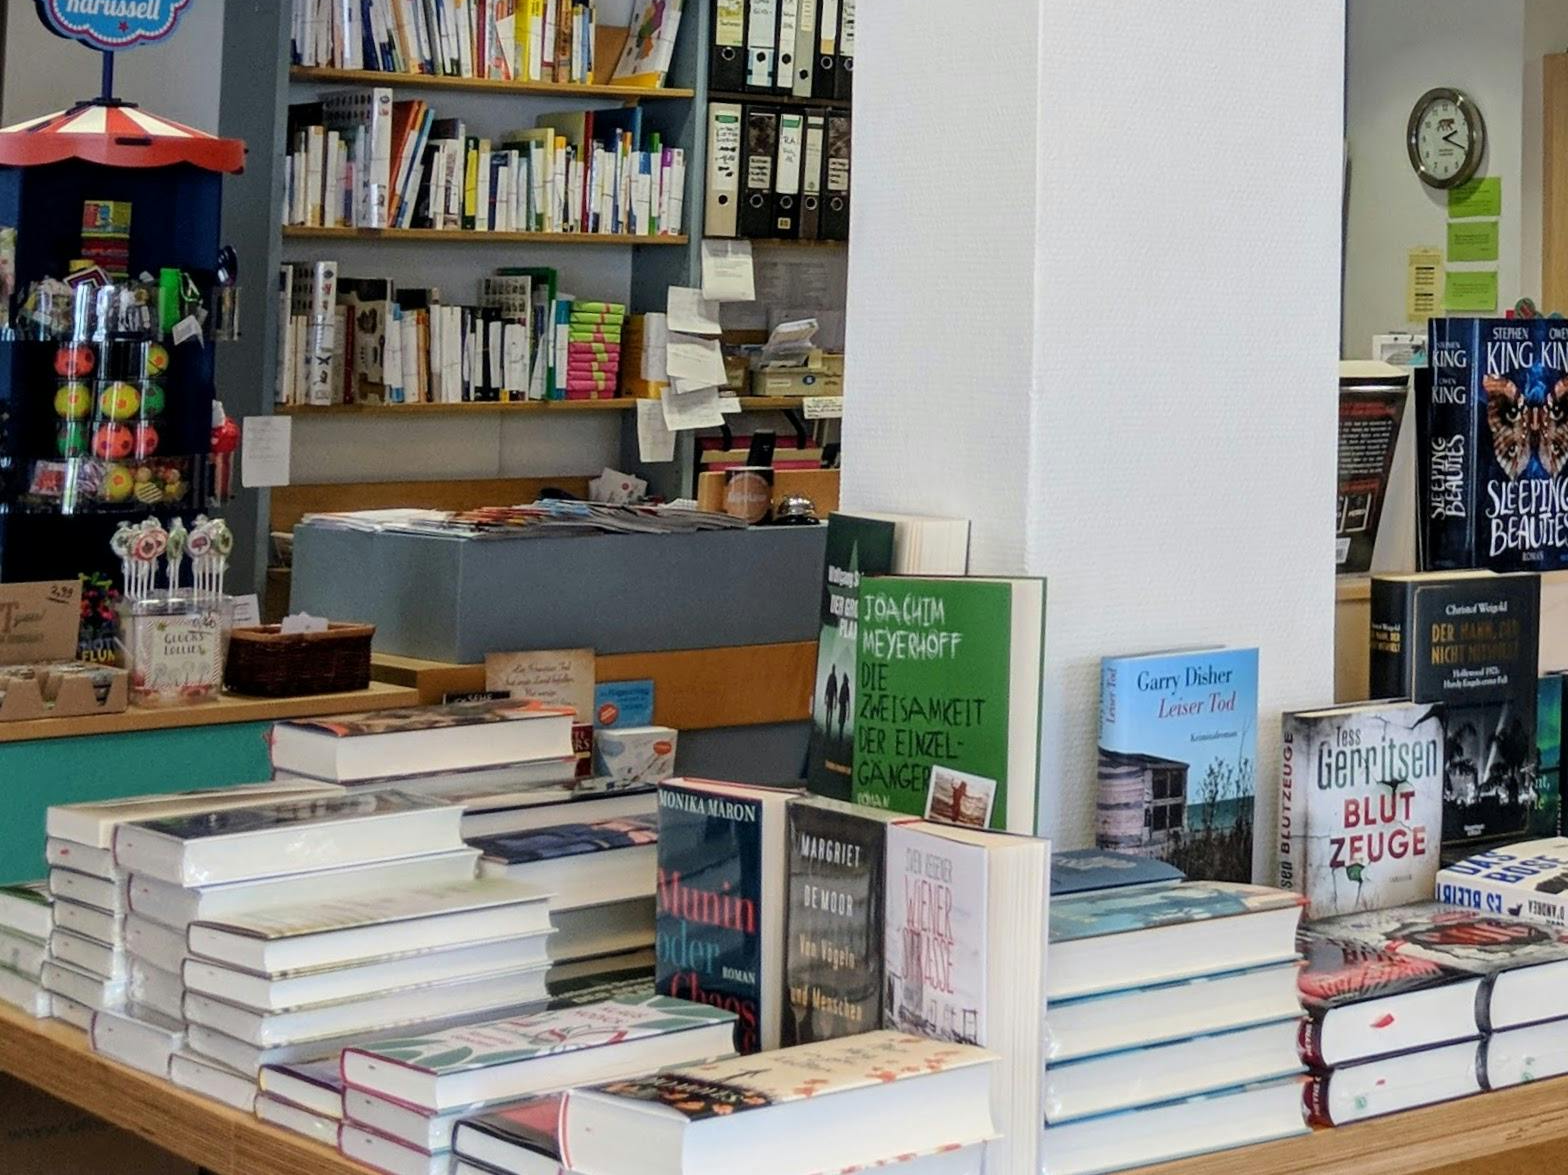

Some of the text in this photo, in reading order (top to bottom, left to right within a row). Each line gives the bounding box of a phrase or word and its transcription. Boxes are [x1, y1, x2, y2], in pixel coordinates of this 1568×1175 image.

[1492, 327, 1529, 340] STEPHEN
[1432, 350, 1467, 369] KING
[1486, 341, 1533, 379] KING
[1432, 386, 1466, 404] KING
[1431, 436, 1446, 520] SLEEPING
[1445, 433, 1466, 517] BEAUTIES
[864, 594, 945, 626] JOACHIM
[863, 627, 963, 660] MEYERHOFF
[1431, 624, 1455, 643] DER
[1431, 644, 1465, 665] NICHT
[861, 663, 888, 691] DIE
[1137, 664, 1233, 695] Garry Disher
[859, 694, 986, 727] ZWEISAMKEIT
[1105, 667, 1117, 724] Leiser Tod
[1158, 691, 1237, 719] Leiser Tod
[859, 727, 964, 759] DER EINZEL-
[1336, 726, 1361, 748] Tess
[1317, 737, 1437, 790] Gerritsen
[658, 789, 756, 822] MONIKA MARON
[1280, 732, 1294, 854] BLUTZEUGE
[1344, 790, 1415, 829] BLUT
[801, 835, 861, 868] MARGRIET
[1329, 826, 1426, 869] ZEUGE
[1450, 850, 1516, 876] DAS
[657, 867, 756, 936] Munin
[804, 884, 854, 917] DE MOOR
[1486, 894, 1503, 915] ES
[656, 920, 720, 973] oder
[800, 934, 817, 958] Von
[722, 966, 756, 985] ROMAN
[789, 985, 863, 1021] und Menschen
